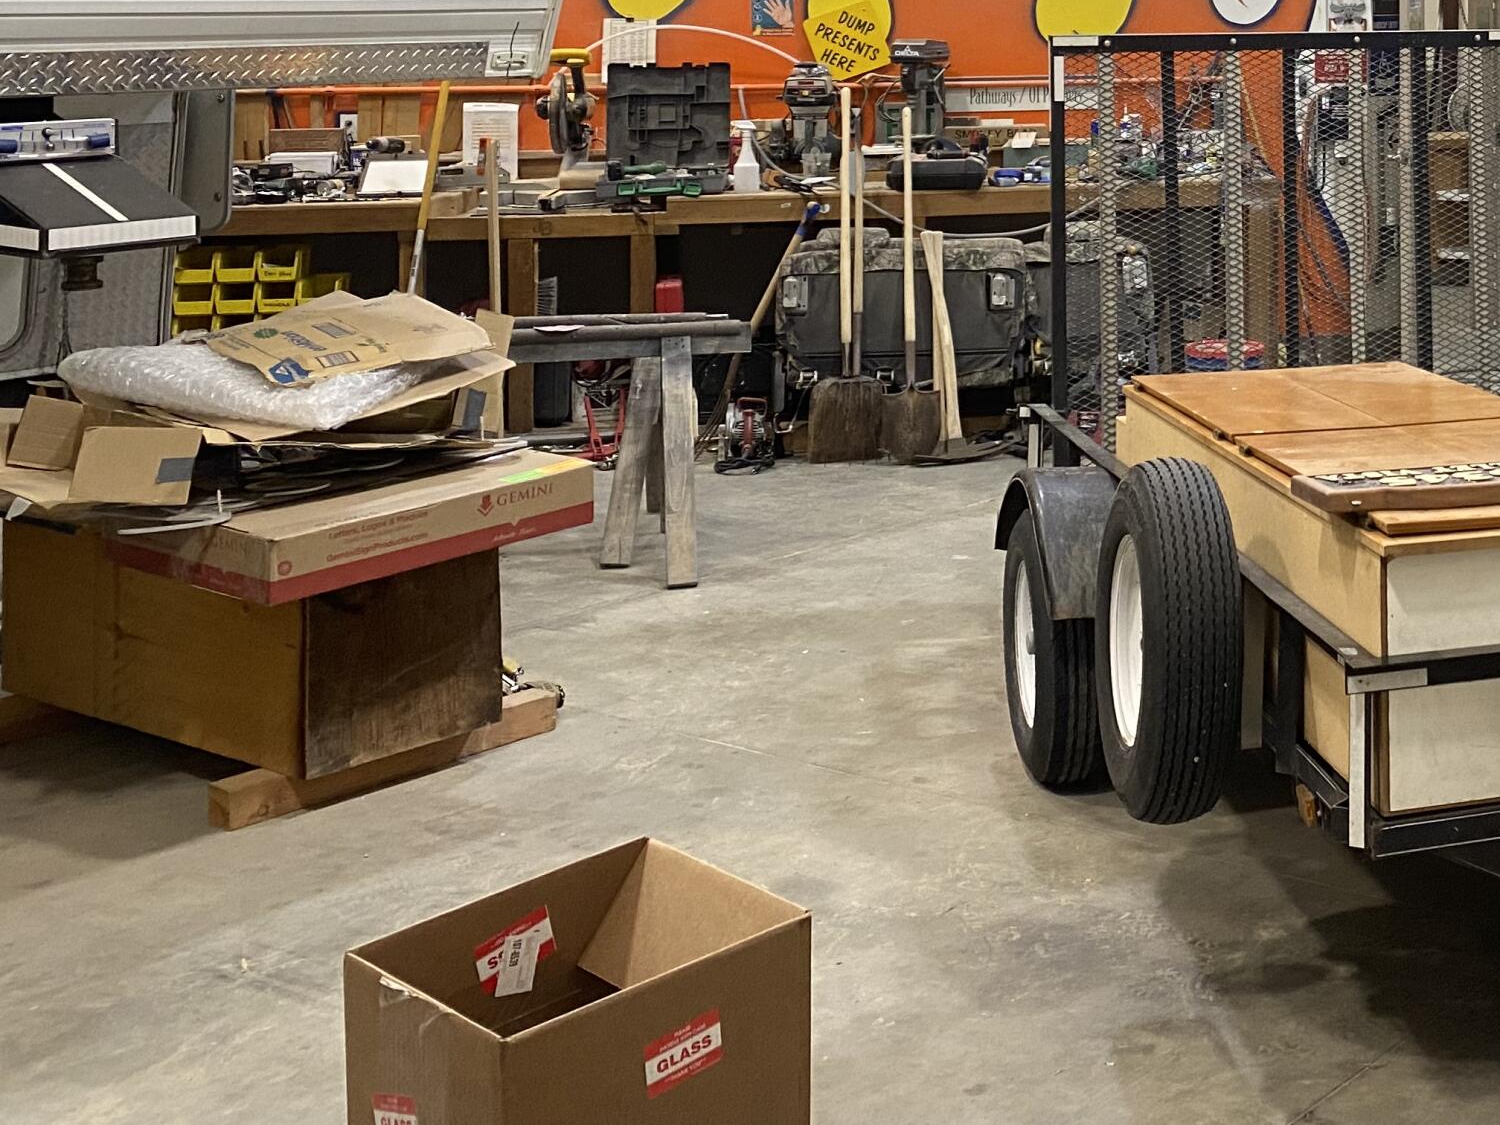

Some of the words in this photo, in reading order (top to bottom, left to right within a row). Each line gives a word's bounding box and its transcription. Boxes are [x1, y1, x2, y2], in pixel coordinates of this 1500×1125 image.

[838, 11, 875, 35] DUMP
[815, 23, 880, 61] PRESENTS
[895, 47, 919, 57] DELTA
[821, 48, 856, 72] HERE
[970, 86, 1017, 107] Pathways
[497, 483, 553, 506] GEMINI
[657, 1034, 712, 1073] GLASS
